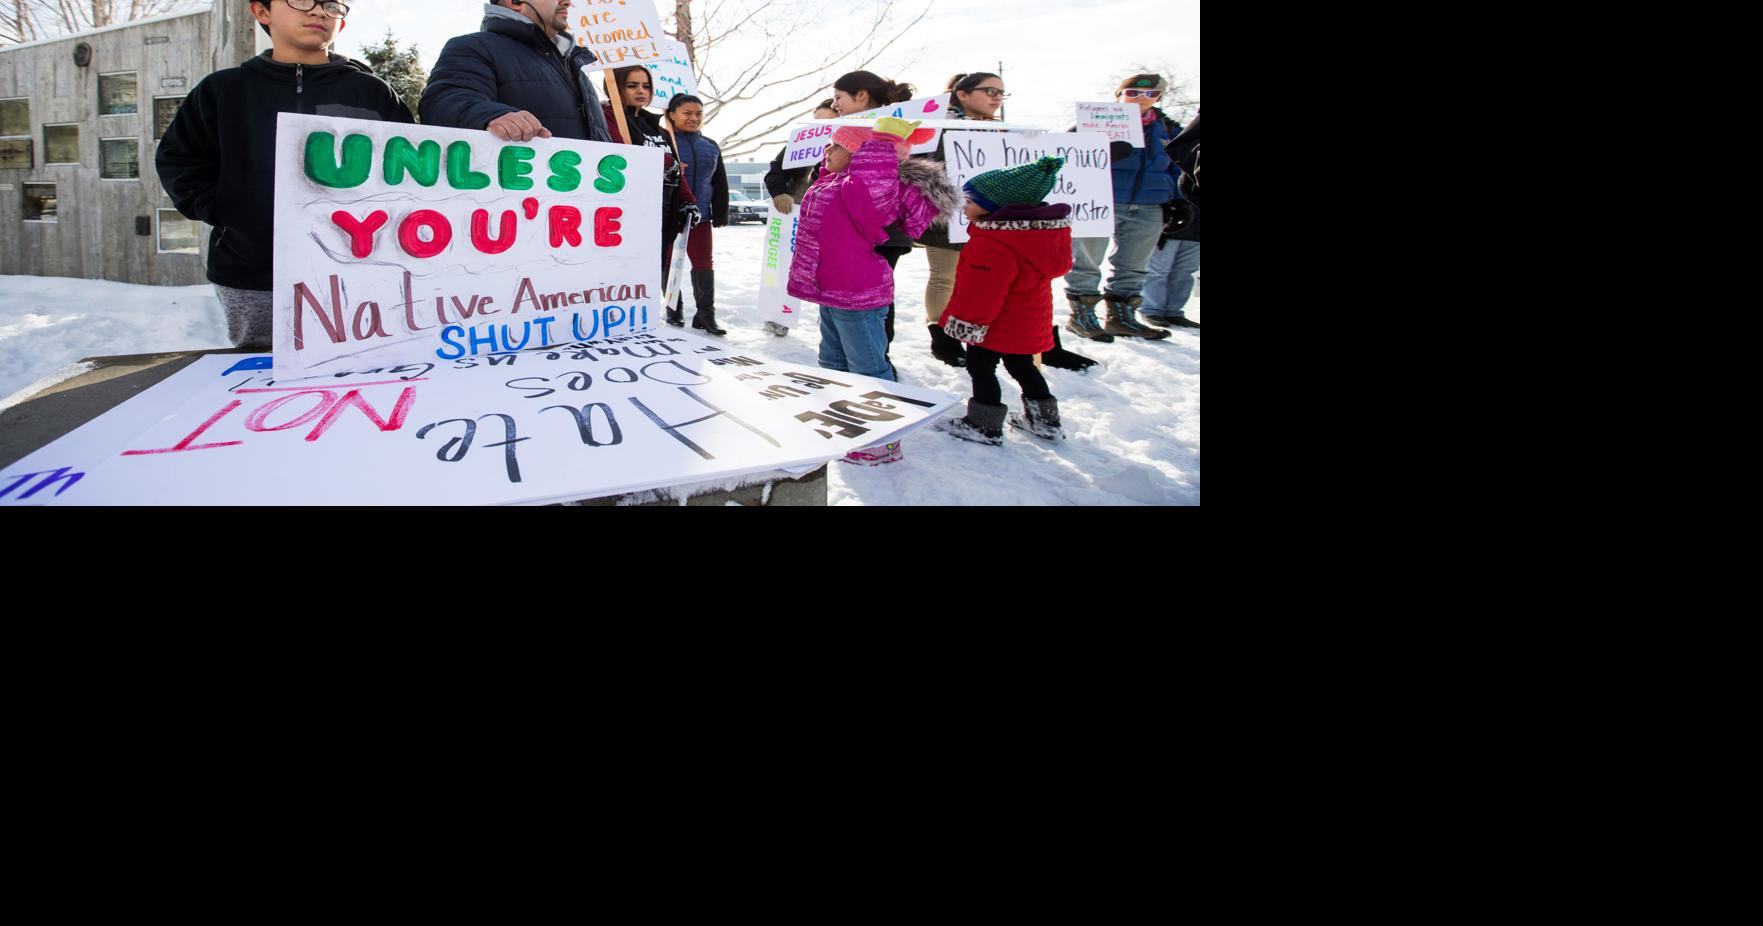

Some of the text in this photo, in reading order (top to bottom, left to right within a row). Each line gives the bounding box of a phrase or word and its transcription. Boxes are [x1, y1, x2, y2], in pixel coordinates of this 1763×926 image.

[578, 21, 654, 47] elcomed
[580, 11, 616, 27] are
[790, 146, 826, 162] REFU
[793, 125, 833, 143] JESUS
[954, 140, 986, 169] No
[303, 131, 627, 192] UNLESS
[1053, 174, 1077, 195] de
[331, 197, 623, 258] YOU'RE
[767, 217, 782, 269] REFUGEE
[294, 270, 651, 350] Native American
[436, 306, 648, 360] SHUT UP!!
[120, 360, 712, 456] Does NOT
[416, 386, 782, 483] Hate
